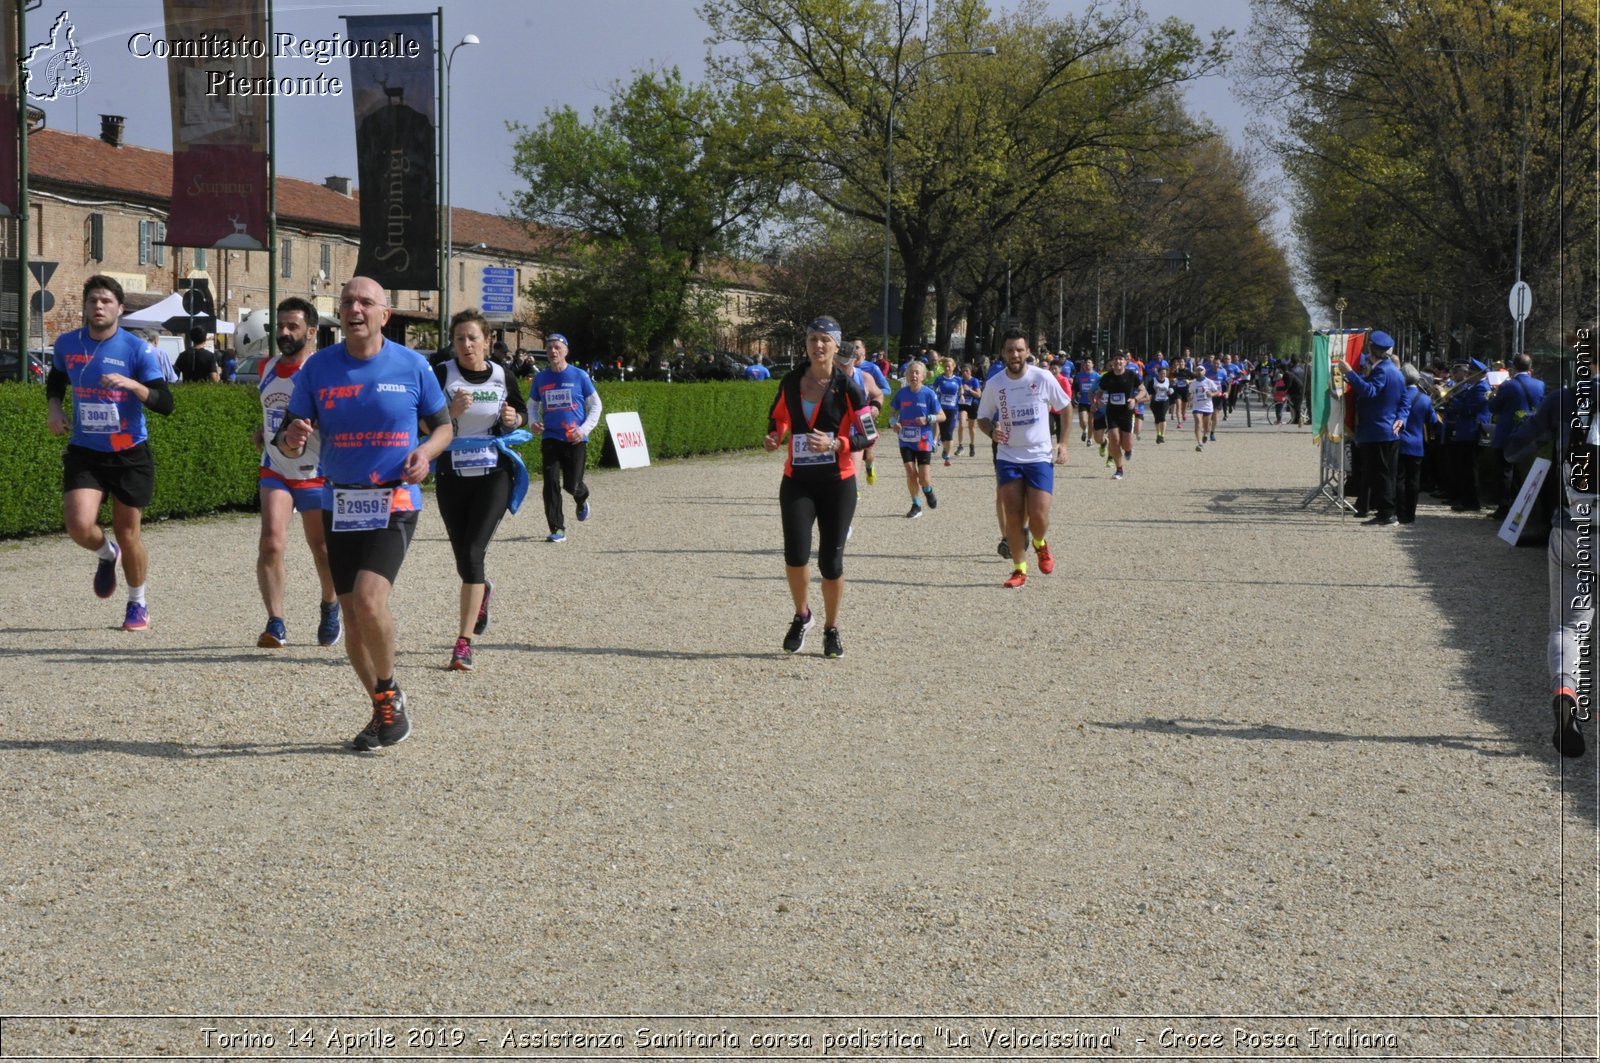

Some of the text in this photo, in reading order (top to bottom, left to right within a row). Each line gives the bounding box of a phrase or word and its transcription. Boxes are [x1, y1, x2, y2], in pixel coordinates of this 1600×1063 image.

[187, 174, 254, 198] Stupinigi
[375, 148, 411, 272] Stupinigi
[999, 388, 1009, 419] ROSSA
[87, 410, 109, 421] 3047
[1016, 408, 1035, 417] 2349
[335, 431, 409, 442] VELOCISSIMA
[616, 431, 644, 449] GIMAX
[346, 499, 380, 514] 2959
